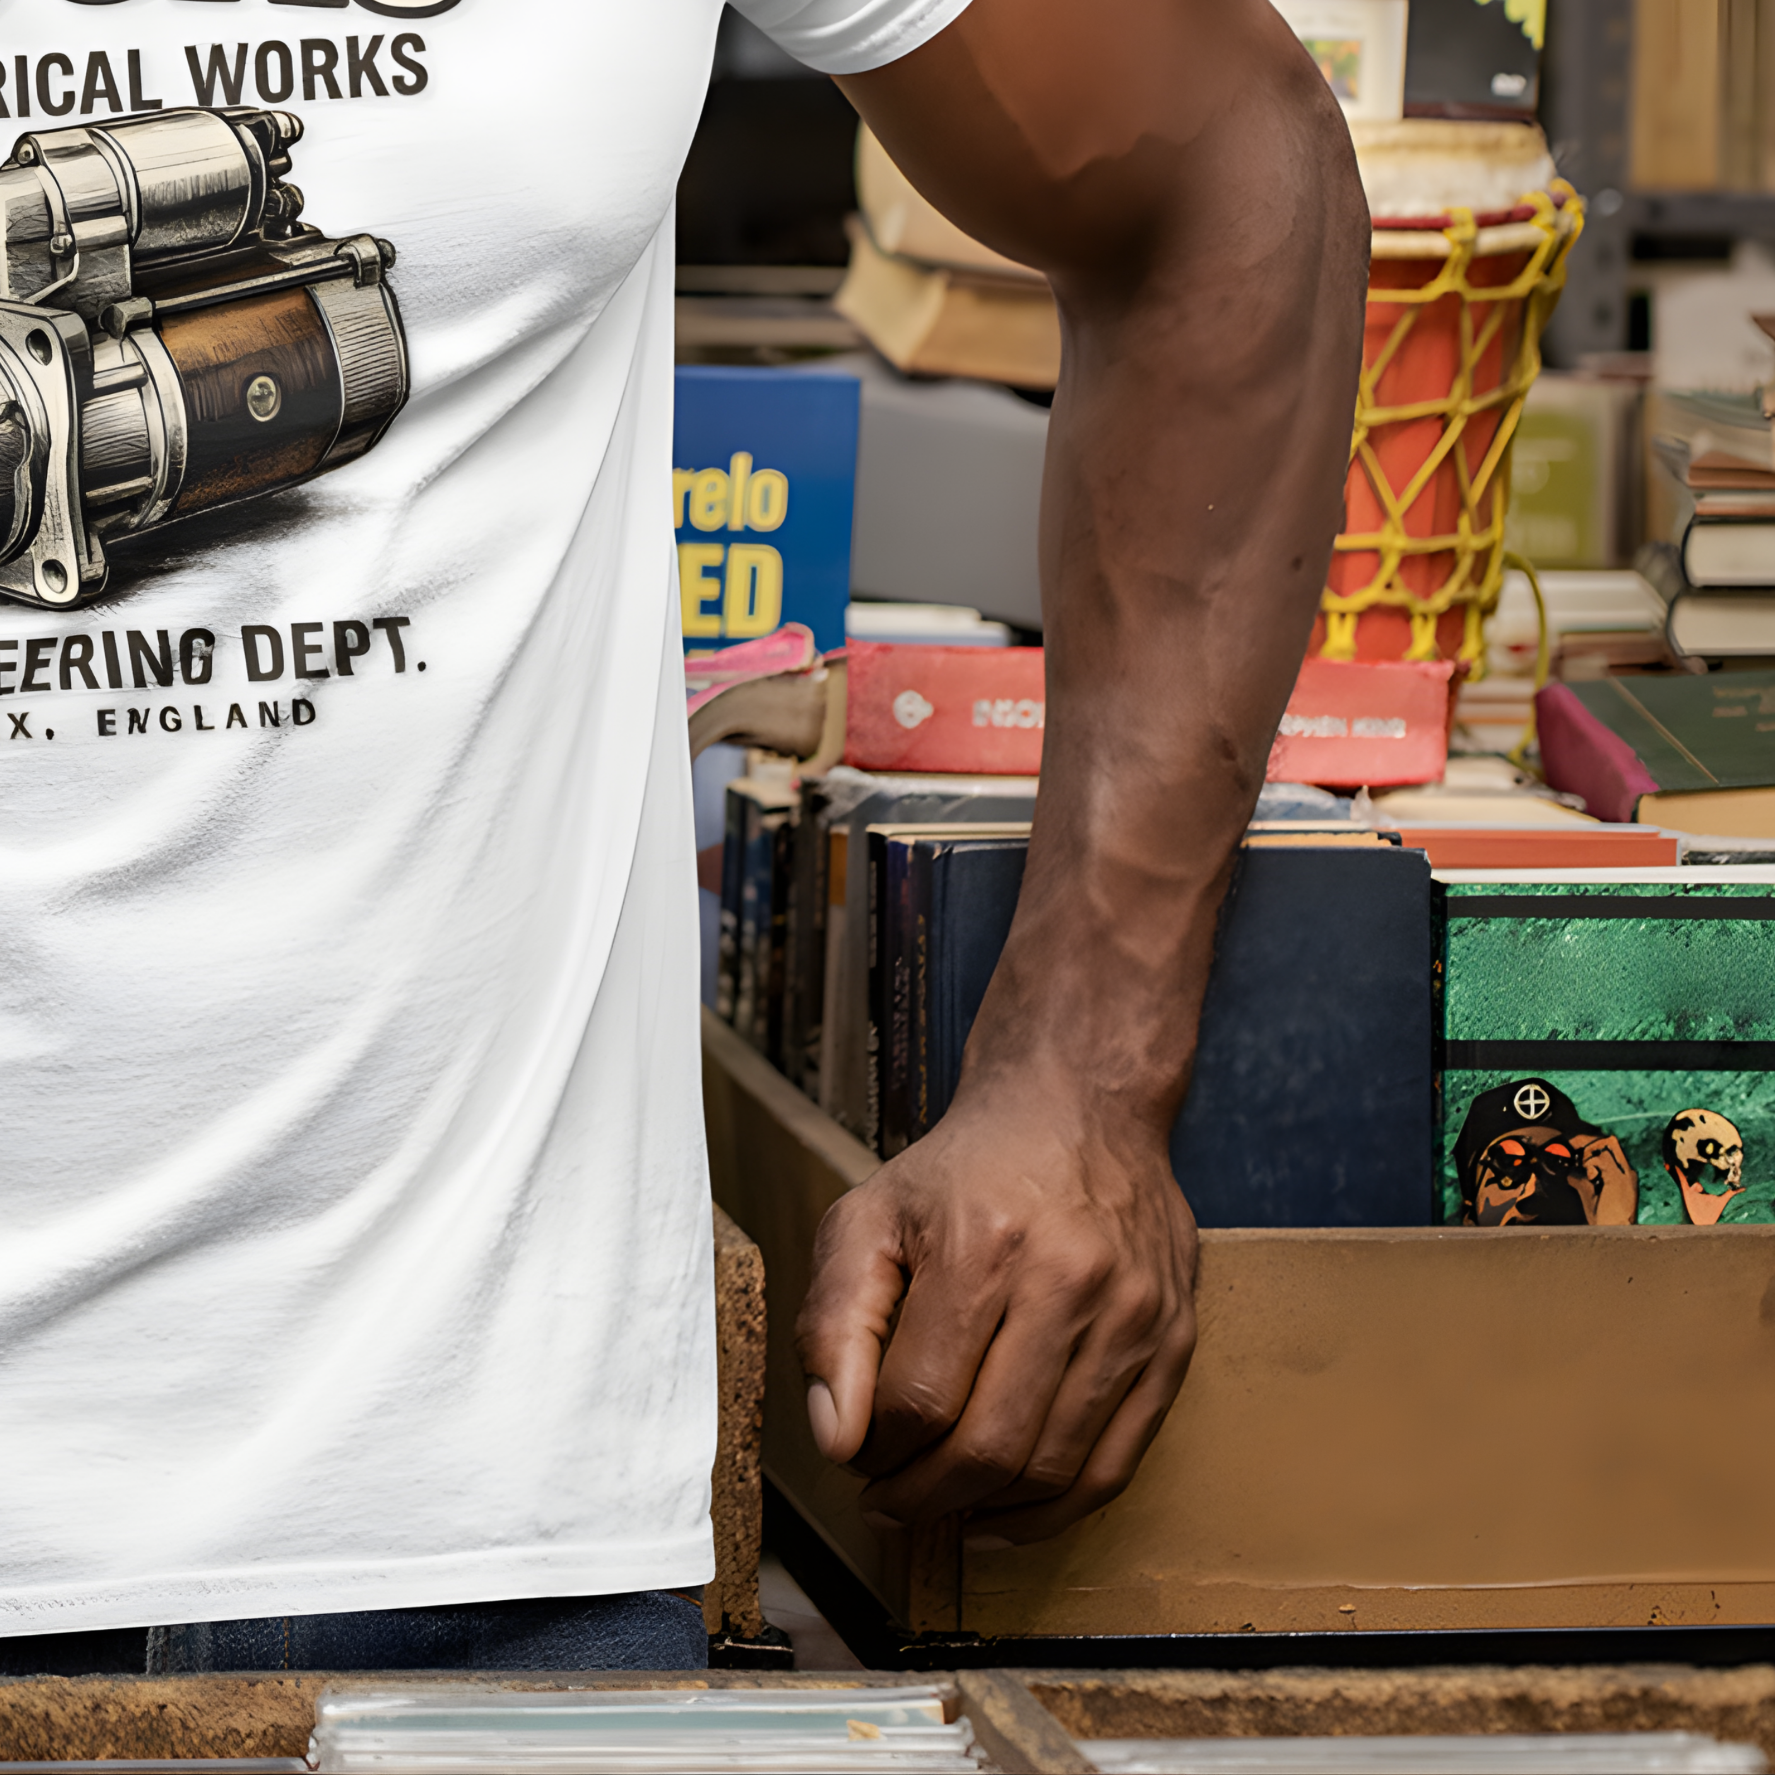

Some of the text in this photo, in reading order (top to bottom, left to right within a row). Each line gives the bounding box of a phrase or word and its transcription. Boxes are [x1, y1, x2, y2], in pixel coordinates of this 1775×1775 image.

[185, 31, 429, 109] WORKS
[241, 615, 428, 683] DEPT.
[96, 698, 316, 736] ENGLAND
